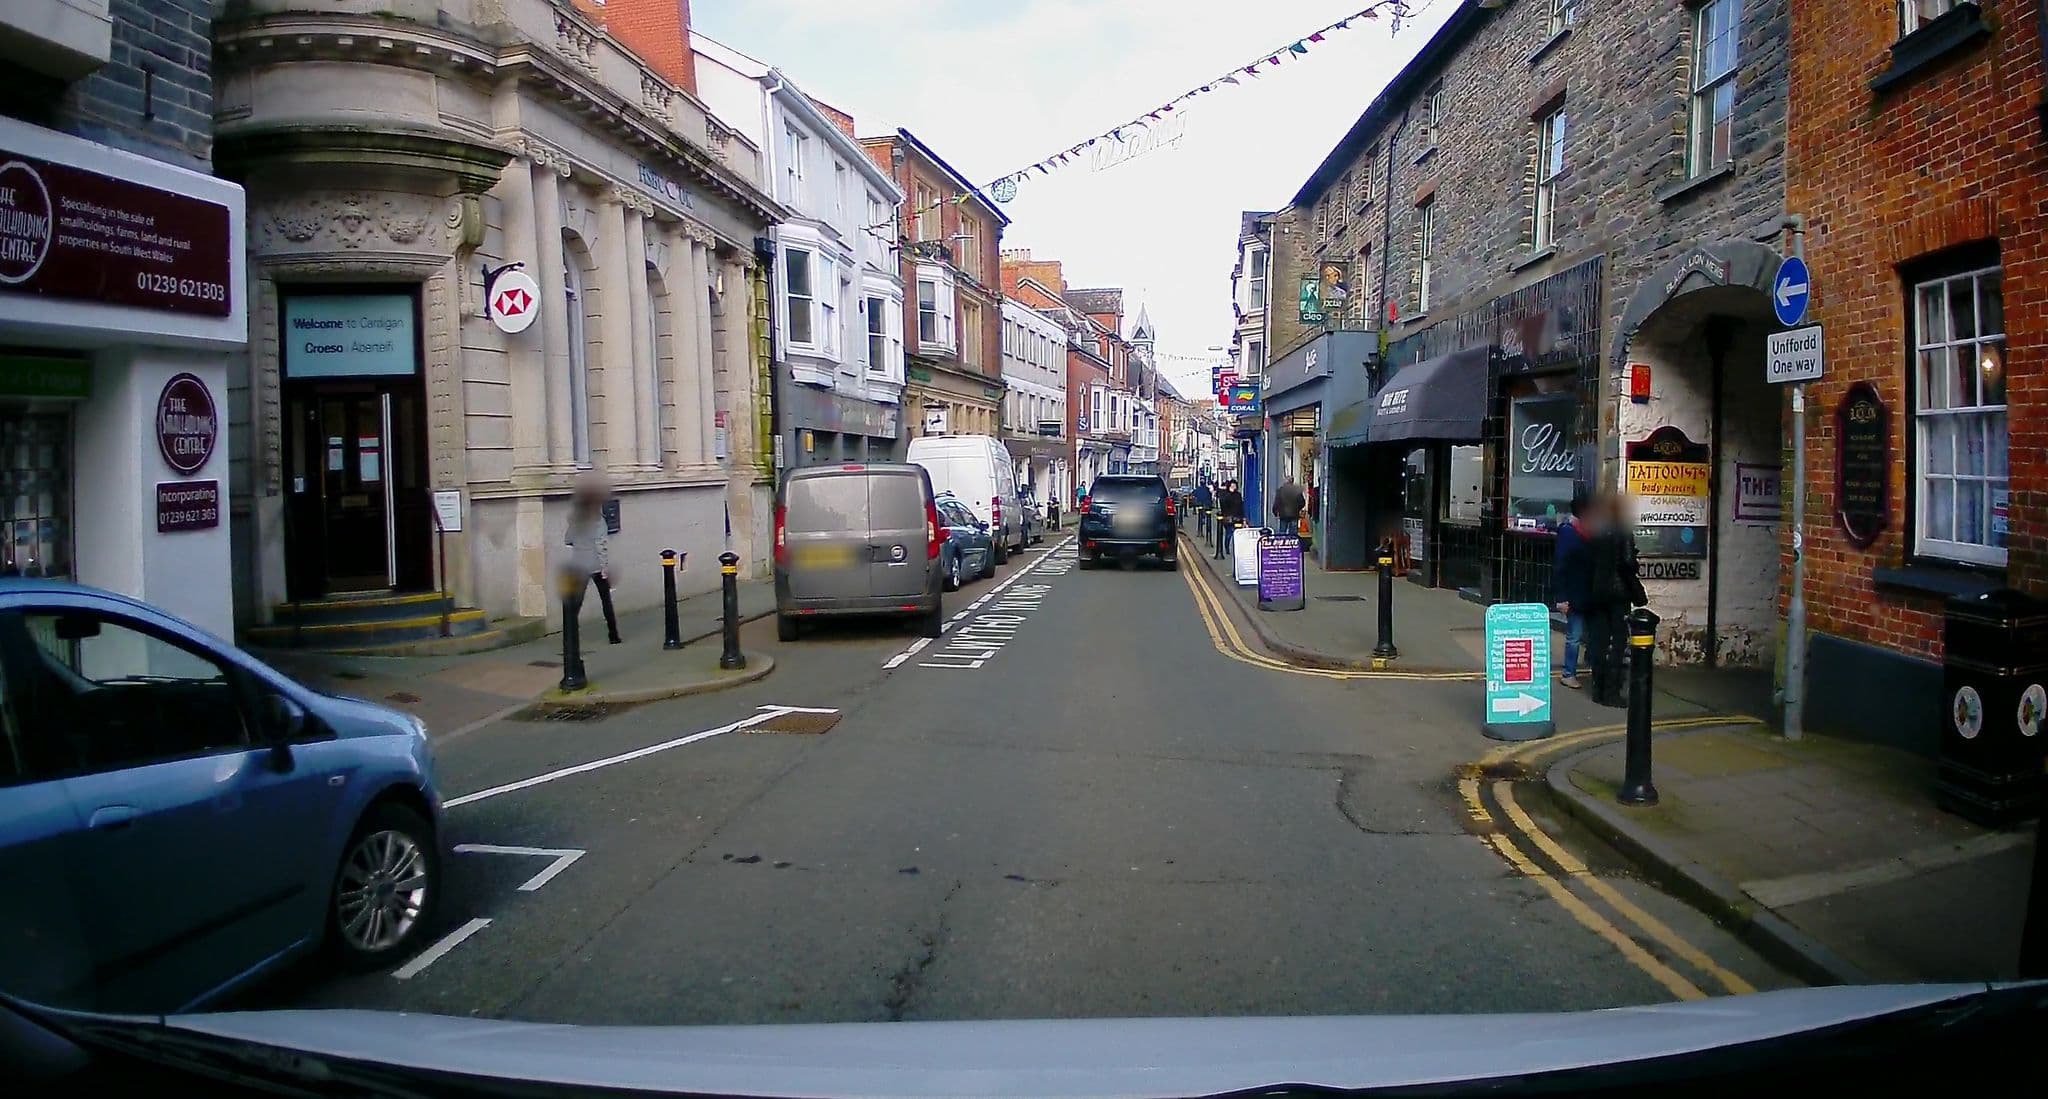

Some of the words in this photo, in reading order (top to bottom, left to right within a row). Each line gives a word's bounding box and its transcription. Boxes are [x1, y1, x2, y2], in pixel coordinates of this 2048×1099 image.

[61, 196, 107, 218] Specialising
[108, 207, 116, 217] in
[117, 208, 130, 222] the
[130, 211, 146, 224] sale
[146, 216, 155, 226] of
[140, 230, 158, 244] land
[158, 234, 173, 246] and
[0, 237, 36, 263] ENTRE
[59, 234, 99, 250] properties
[110, 243, 132, 256] South
[134, 246, 152, 260] West
[153, 249, 174, 263] Wales
[1688, 254, 1705, 268] LION
[138, 271, 177, 294] 01239
[180, 278, 225, 301] 621303
[293, 317, 344, 330] Welcome
[347, 318, 357, 329] to
[360, 316, 405, 331] Cardigan
[305, 342, 344, 354] Croeso
[1772, 335, 1817, 355] Unffordd
[1773, 362, 1793, 374] One
[1796, 358, 1816, 374] way
[1630, 465, 1706, 480] TATTOOISTS
[1641, 482, 1661, 494] body
[1743, 477, 1773, 496] THE
[159, 488, 217, 504] Incorporating
[160, 510, 185, 525] 01239
[185, 509, 201, 522] 621
[1640, 512, 1696, 524] WHOLEFOODS
[1638, 561, 1697, 578] crowes
[918, 613, 1027, 669] LLWYTHO
